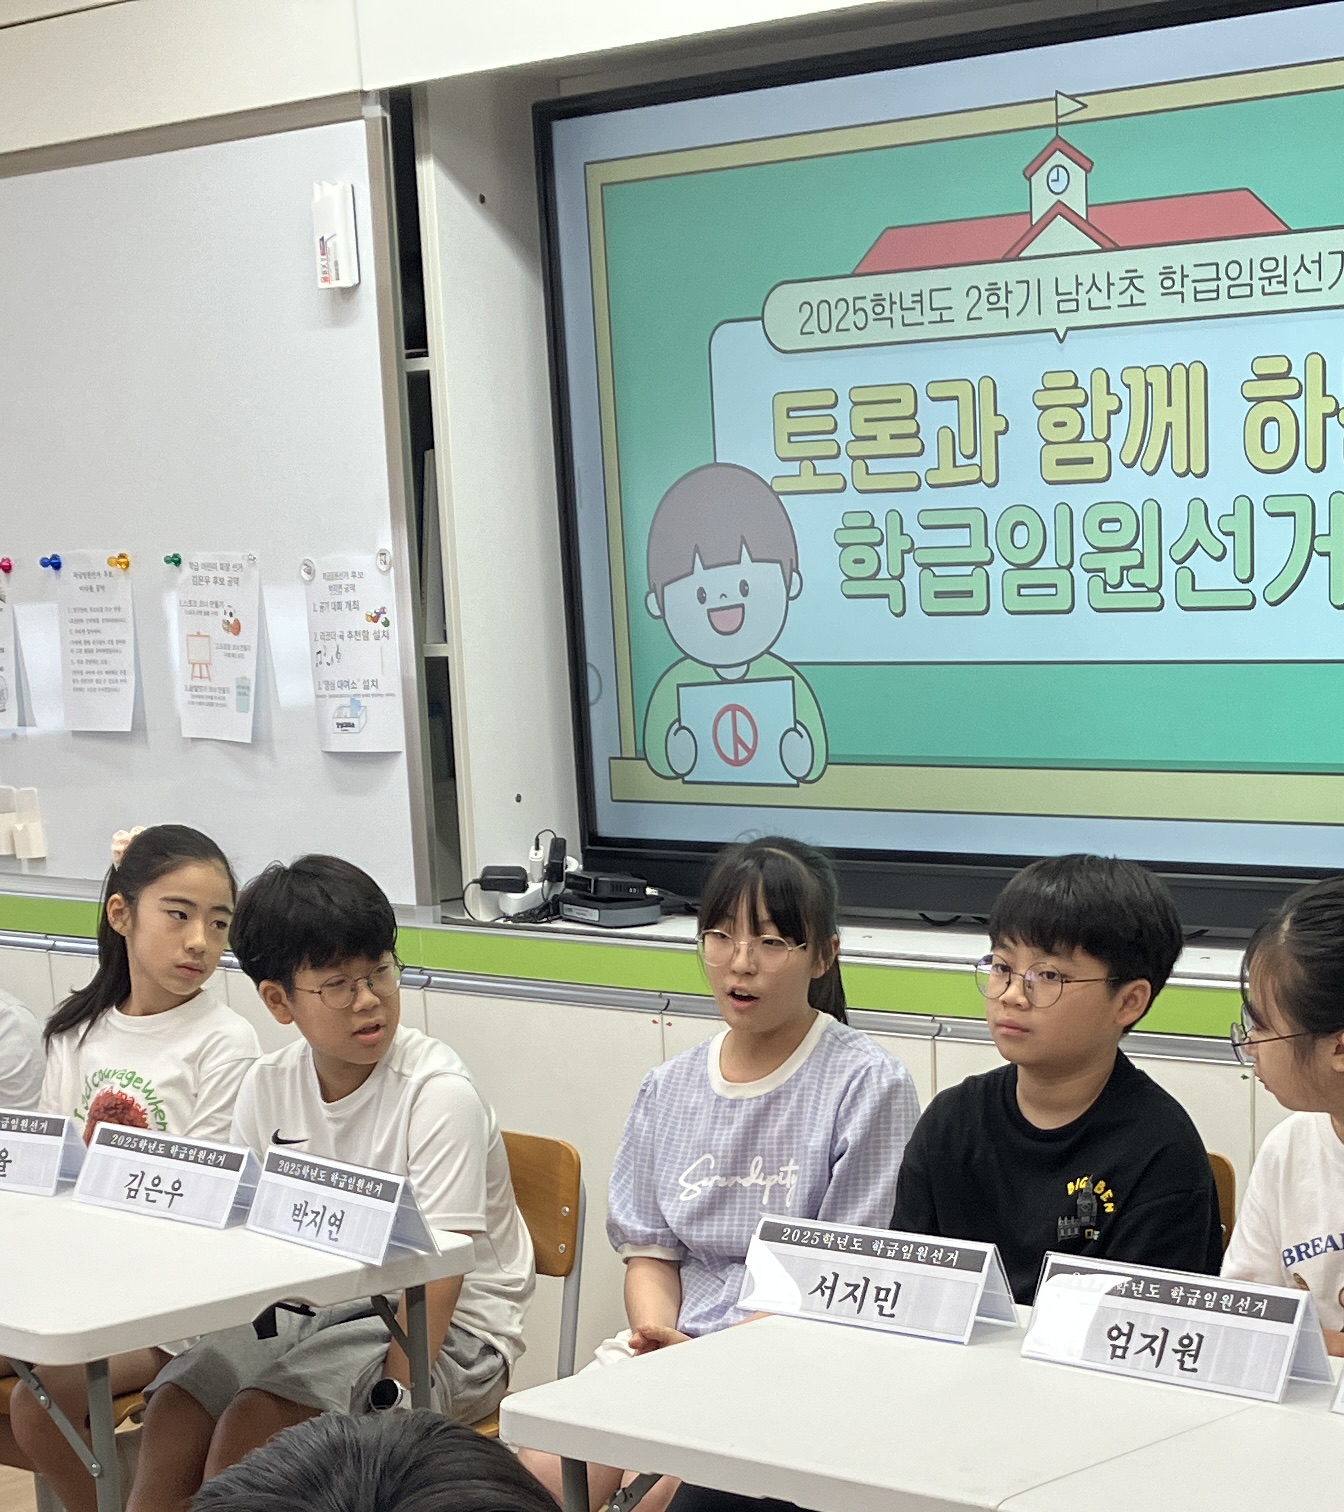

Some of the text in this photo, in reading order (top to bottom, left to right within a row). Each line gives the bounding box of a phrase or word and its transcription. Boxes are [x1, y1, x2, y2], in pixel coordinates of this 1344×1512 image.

[798, 286, 956, 337] 2025학년도
[965, 276, 1044, 322] 2학기
[1054, 267, 1148, 313] 남산초
[771, 375, 1009, 494] 토론과
[1032, 360, 1208, 484] 함께
[91, 1067, 144, 1089] courage
[141, 1079, 168, 1132] when
[109, 1133, 228, 1168] 2025학년도 학급임원선거
[122, 1169, 185, 1209] 김은우
[277, 1159, 384, 1198] 2025학년도 학급임원선거
[678, 1153, 800, 1208] Serendipity
[1066, 1175, 1116, 1214] BIG BEN
[291, 1199, 346, 1243] 박지연
[780, 1226, 961, 1269] 2025학년도 학급임원선거
[808, 1271, 904, 1320] 서지민
[1170, 1285, 1269, 1318] 학급임원선거
[1106, 1320, 1205, 1374] 엄지원
